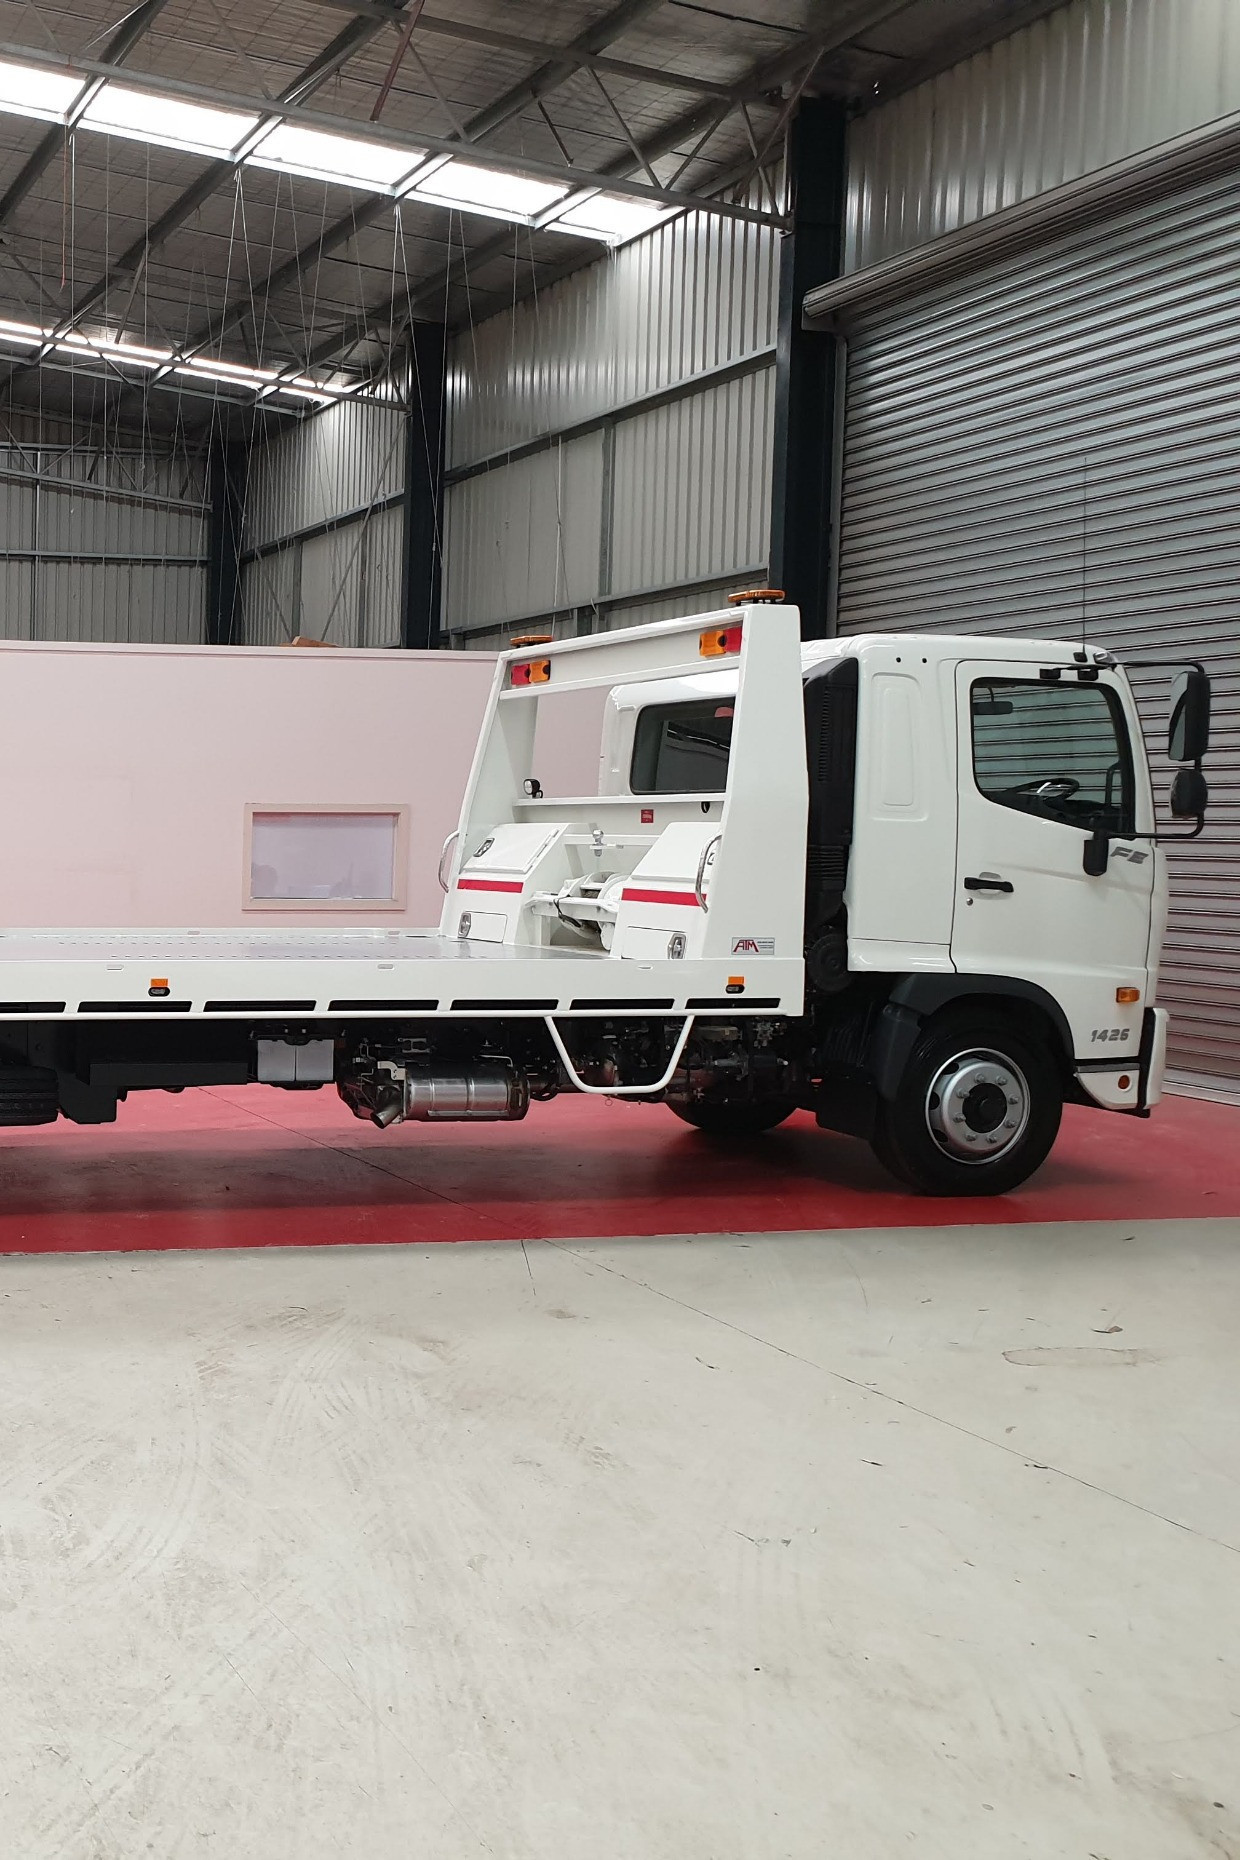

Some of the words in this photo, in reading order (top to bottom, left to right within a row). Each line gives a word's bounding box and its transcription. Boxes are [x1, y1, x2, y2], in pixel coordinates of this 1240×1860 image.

[1110, 846, 1149, 865] FE
[732, 939, 760, 953] ATM
[1090, 1028, 1130, 1042] 1426
